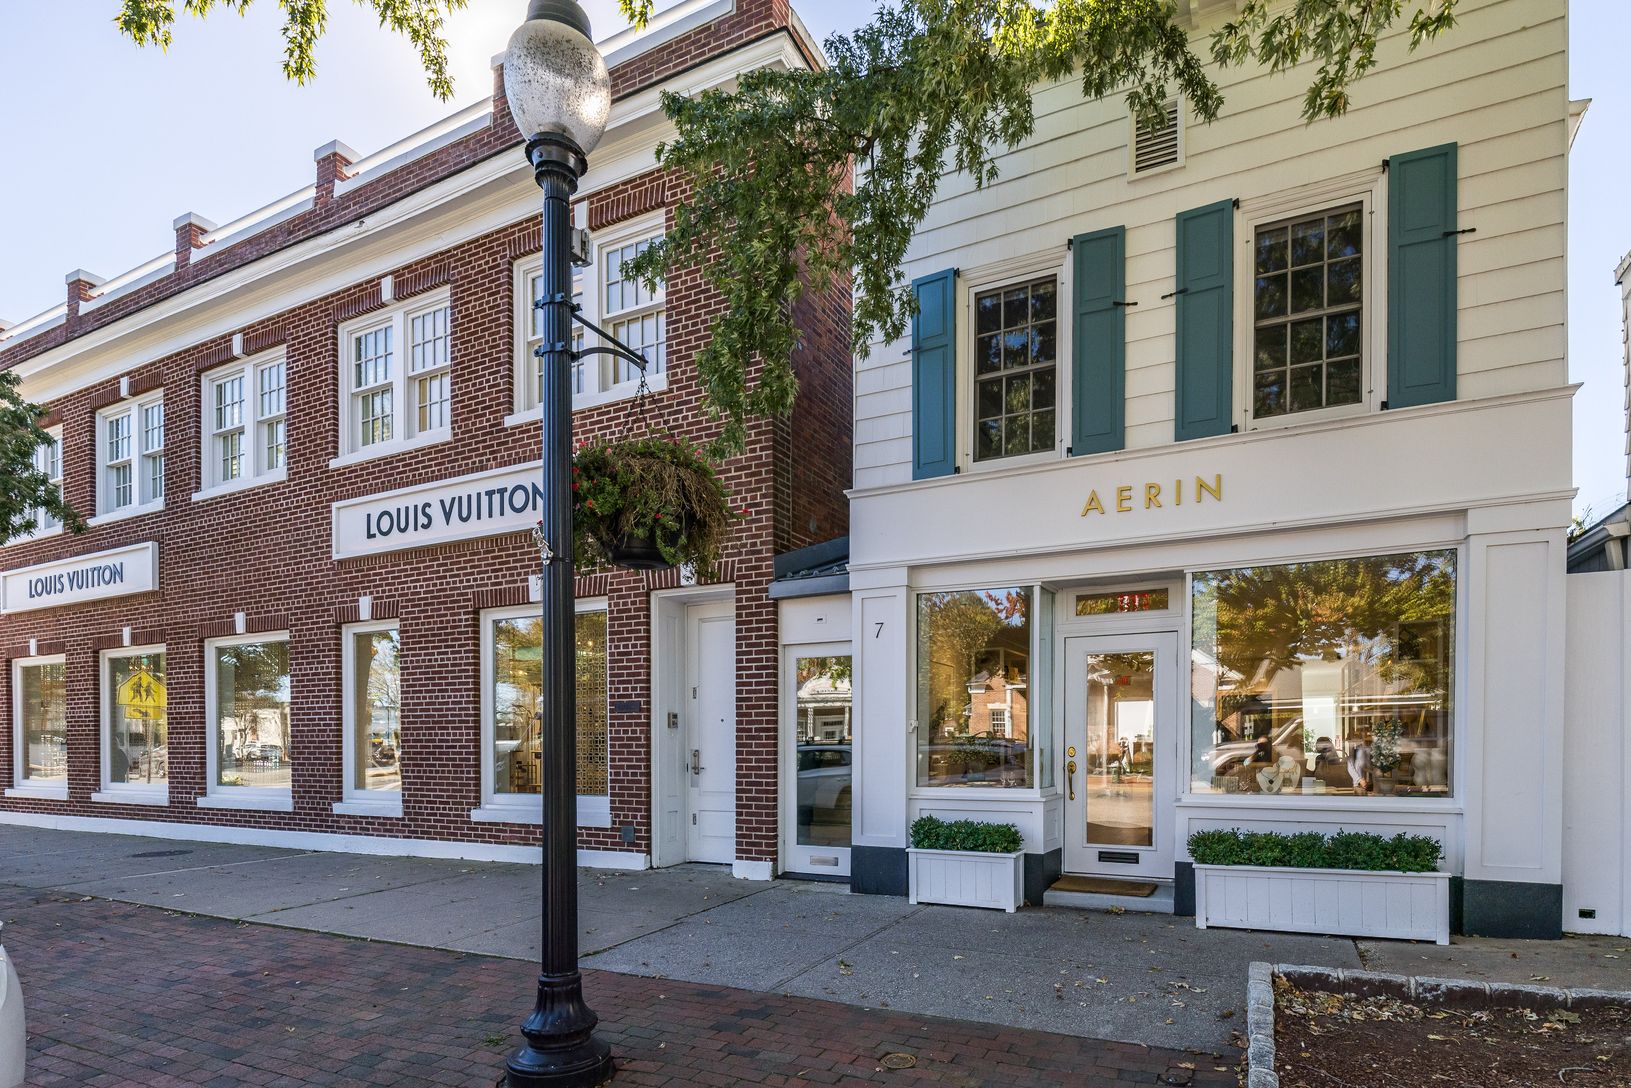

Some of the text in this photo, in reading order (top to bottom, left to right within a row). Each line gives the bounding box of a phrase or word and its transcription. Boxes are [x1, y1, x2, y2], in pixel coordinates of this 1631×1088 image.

[1080, 473, 1222, 517] AERIN
[366, 501, 433, 540] LOUIS
[28, 561, 124, 599] LOUIS VUITTON
[874, 622, 885, 639] 7
